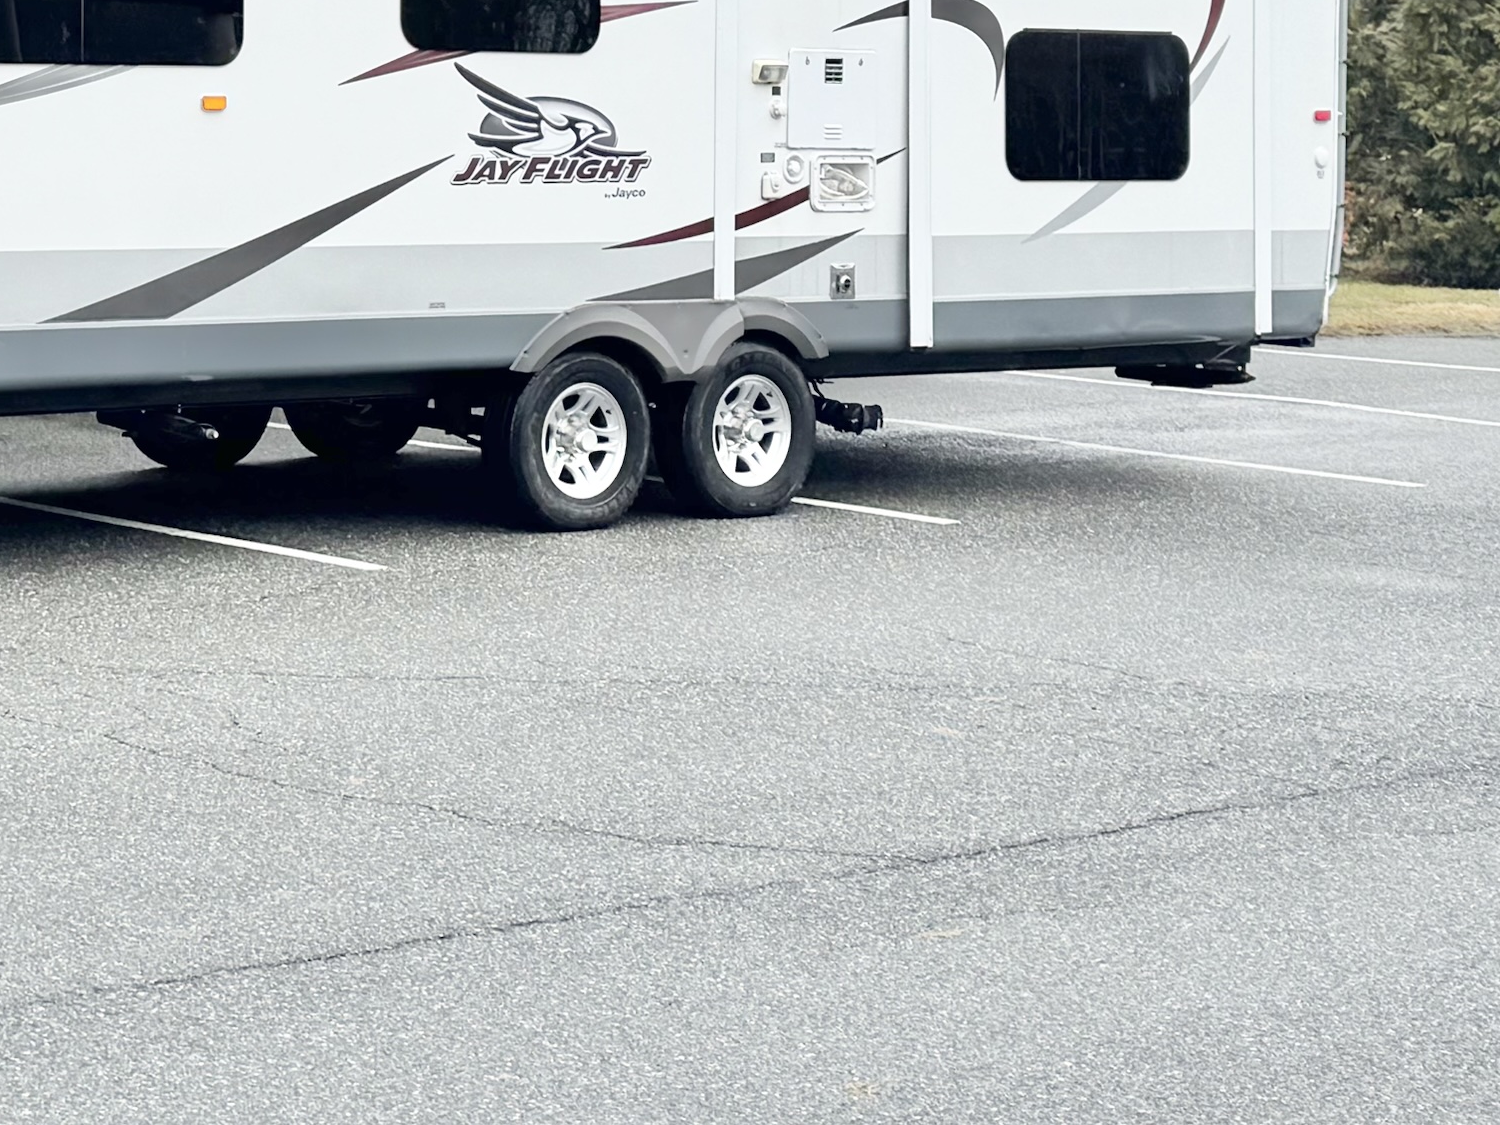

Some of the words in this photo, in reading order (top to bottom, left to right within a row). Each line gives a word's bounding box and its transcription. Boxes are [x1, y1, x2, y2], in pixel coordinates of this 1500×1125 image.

[451, 156, 526, 184] JAY
[520, 155, 651, 183] FLIGHT
[611, 186, 646, 200] Jayco
